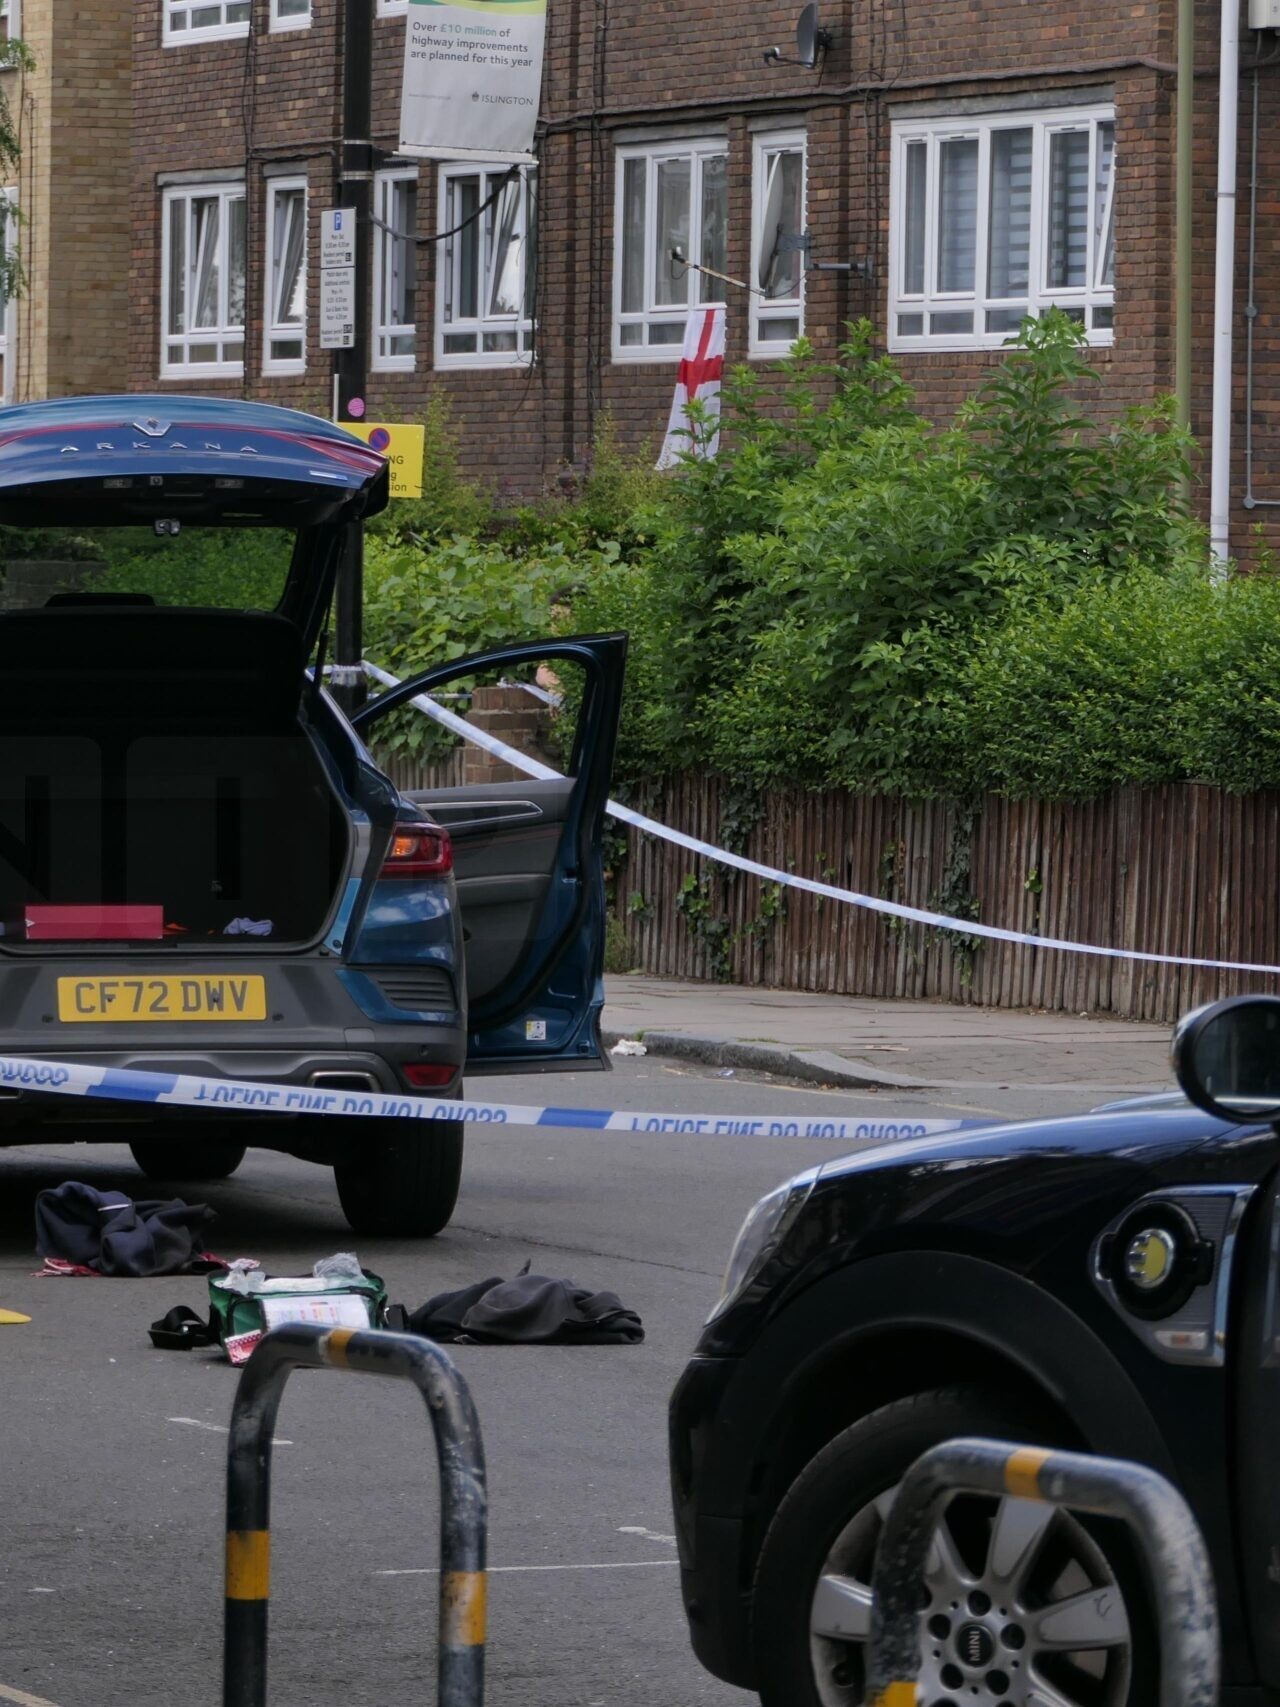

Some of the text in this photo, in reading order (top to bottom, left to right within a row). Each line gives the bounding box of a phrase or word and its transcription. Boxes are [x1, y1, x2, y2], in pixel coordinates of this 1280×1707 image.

[412, 21, 512, 38] Over £10 million of
[411, 35, 529, 53] highway improvements
[410, 50, 533, 68] are planned for this year
[481, 94, 534, 106] ISLINGTON
[60, 441, 258, 453] ARKANA
[75, 980, 248, 1014] CF72 DWV
[968, 1630, 981, 1661] MINI
